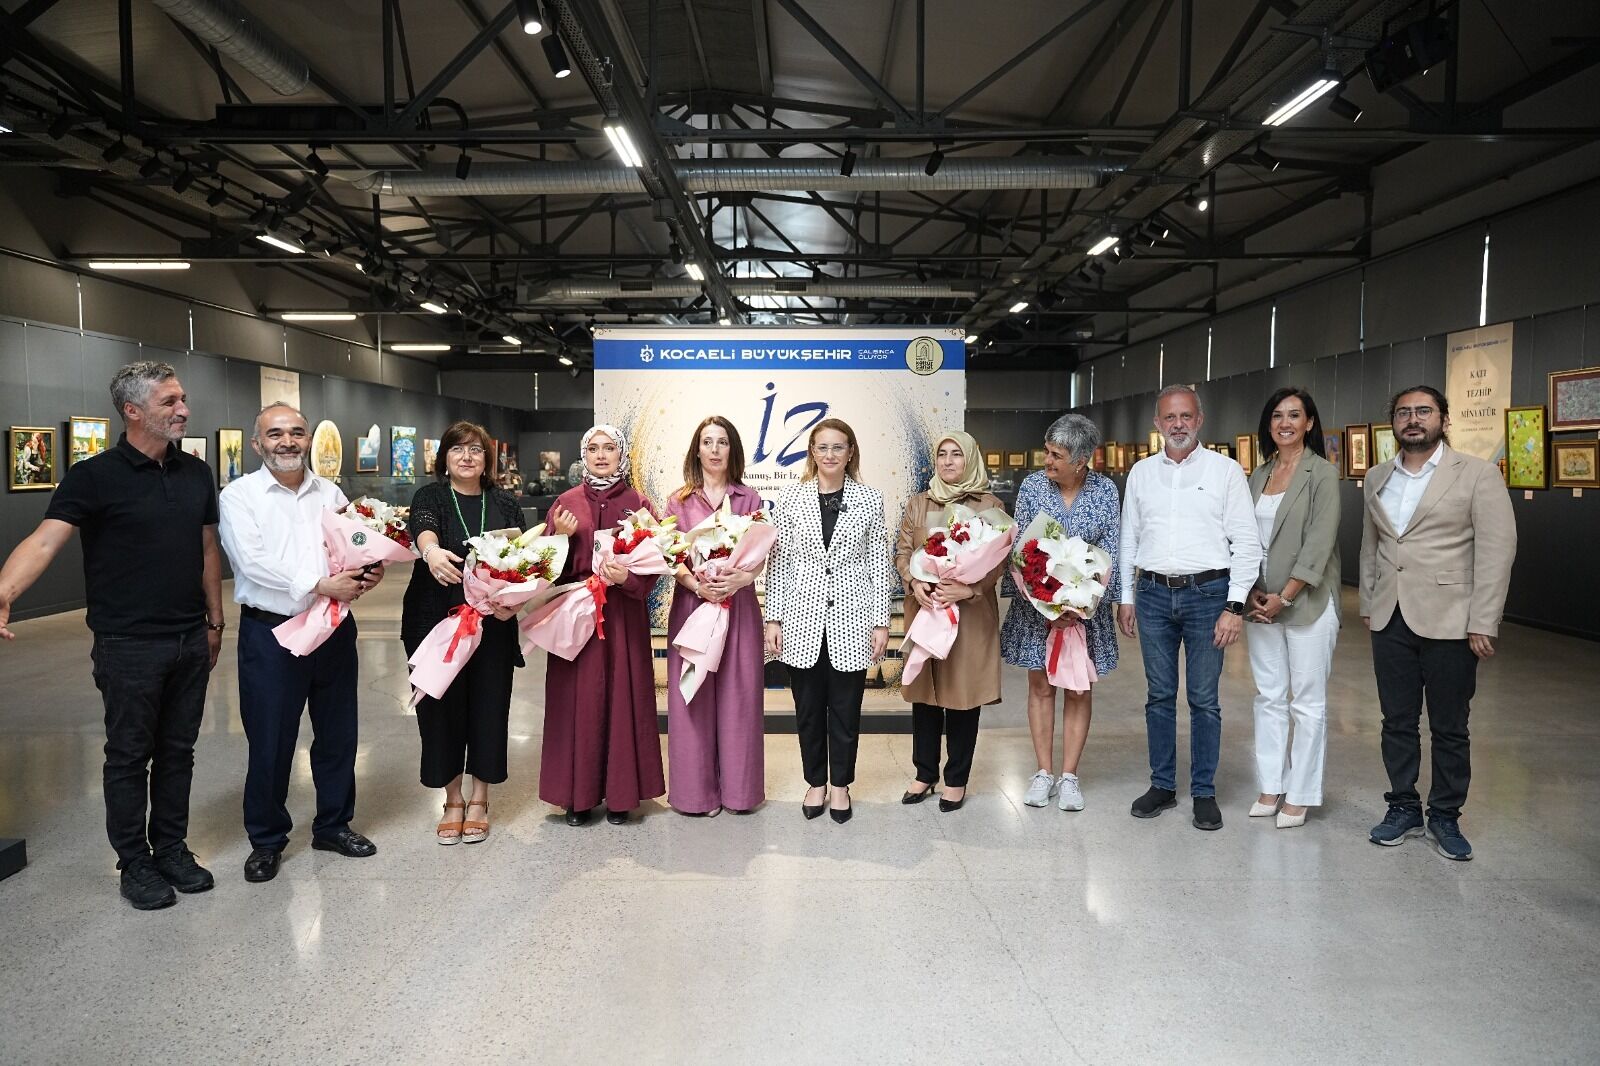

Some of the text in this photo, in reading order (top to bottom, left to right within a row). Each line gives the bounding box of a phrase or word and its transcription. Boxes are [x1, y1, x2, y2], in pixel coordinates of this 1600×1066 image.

[741, 349, 852, 362] BÜYÜKŞEHİR
[1466, 387, 1492, 398] TEZHİP
[743, 471, 772, 481] kunuş,
[774, 471, 787, 480] Bir
